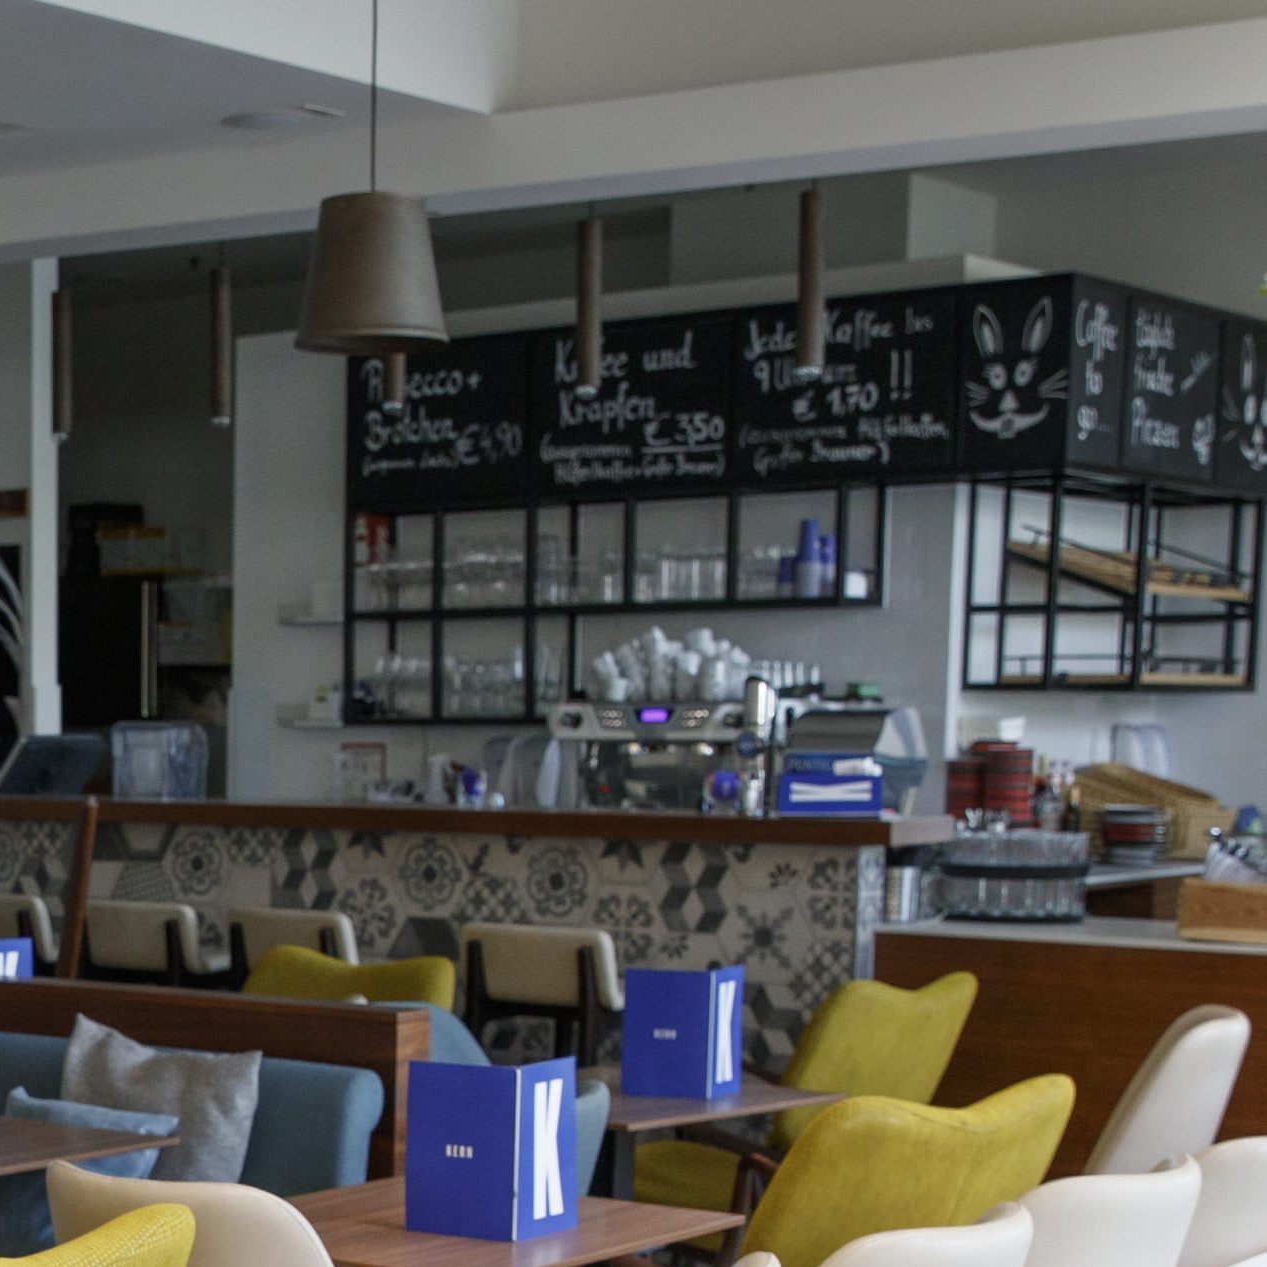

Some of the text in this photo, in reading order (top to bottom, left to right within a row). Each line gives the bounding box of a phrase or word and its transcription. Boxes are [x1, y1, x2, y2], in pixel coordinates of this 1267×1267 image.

[642, 329, 697, 373] und
[558, 380, 656, 435] Krapfen
[715, 979, 737, 1085] K
[445, 1143, 474, 1159] KERN
[533, 1077, 565, 1222] K
